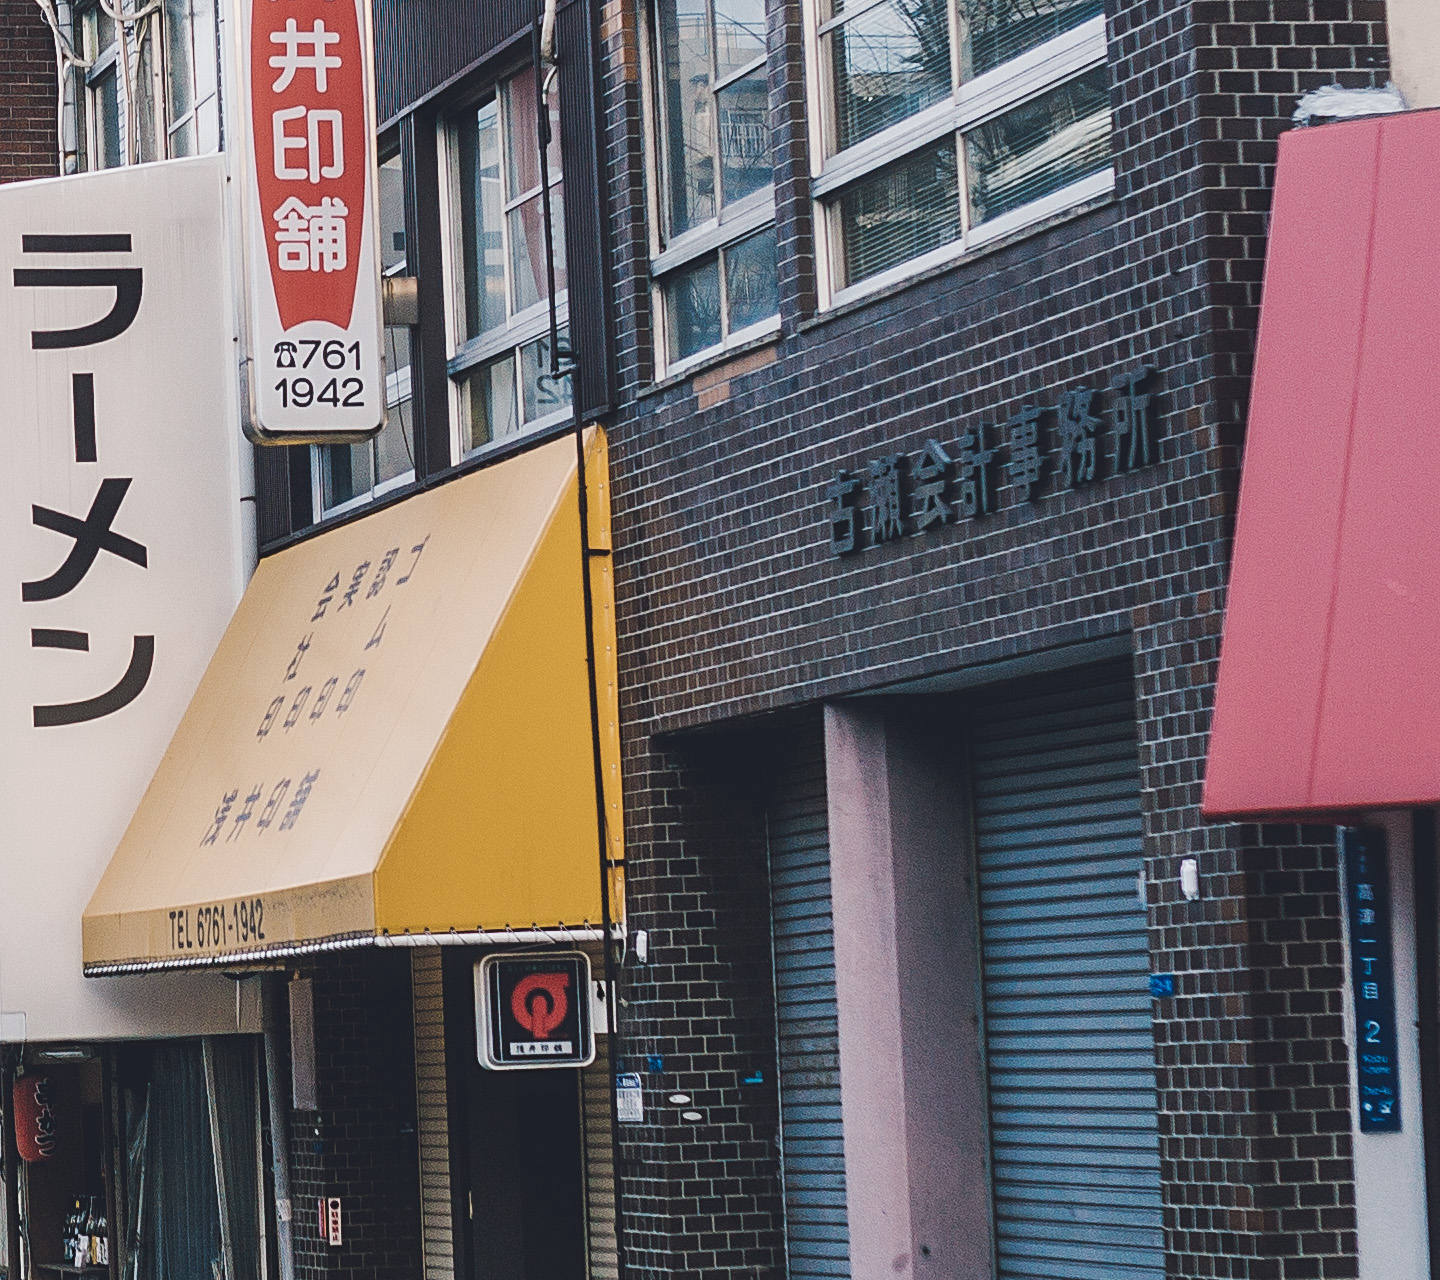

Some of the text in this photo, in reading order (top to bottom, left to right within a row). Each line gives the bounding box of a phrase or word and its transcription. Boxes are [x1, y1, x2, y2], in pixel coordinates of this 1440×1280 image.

[299, 340, 361, 370] 761
[275, 377, 364, 409] 1942
[13, 234, 154, 727] ラーメン
[169, 898, 266, 950] TEL 6761-1942
[1364, 1021, 1381, 1043] 2
